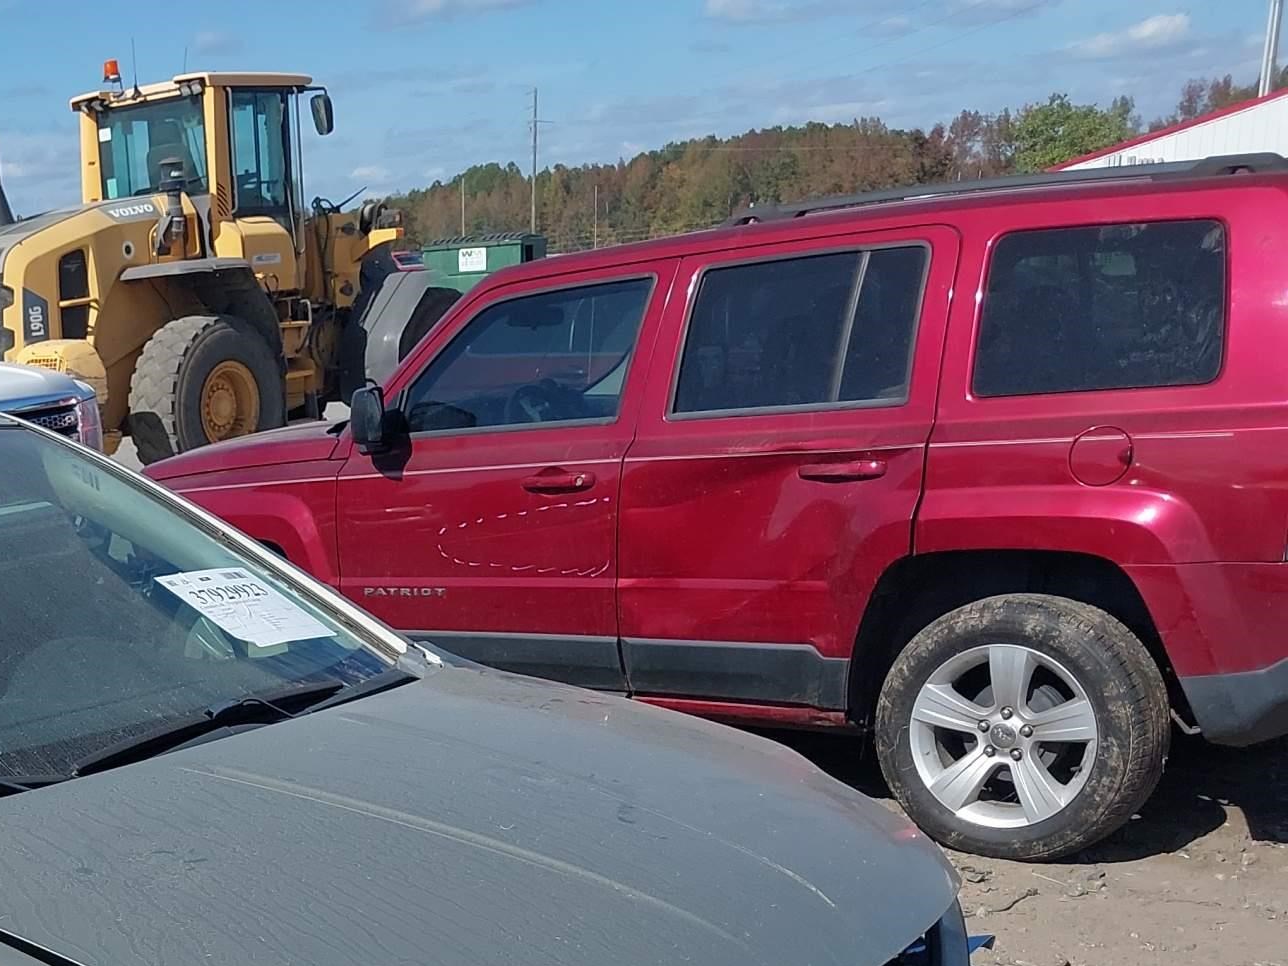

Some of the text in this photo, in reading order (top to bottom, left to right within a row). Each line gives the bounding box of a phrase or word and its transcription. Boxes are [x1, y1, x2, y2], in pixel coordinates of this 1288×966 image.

[109, 204, 153, 217] VOLVO
[28, 305, 45, 337] L90G
[188, 582, 269, 605] 37929923
[363, 587, 447, 597] PATRIOT
